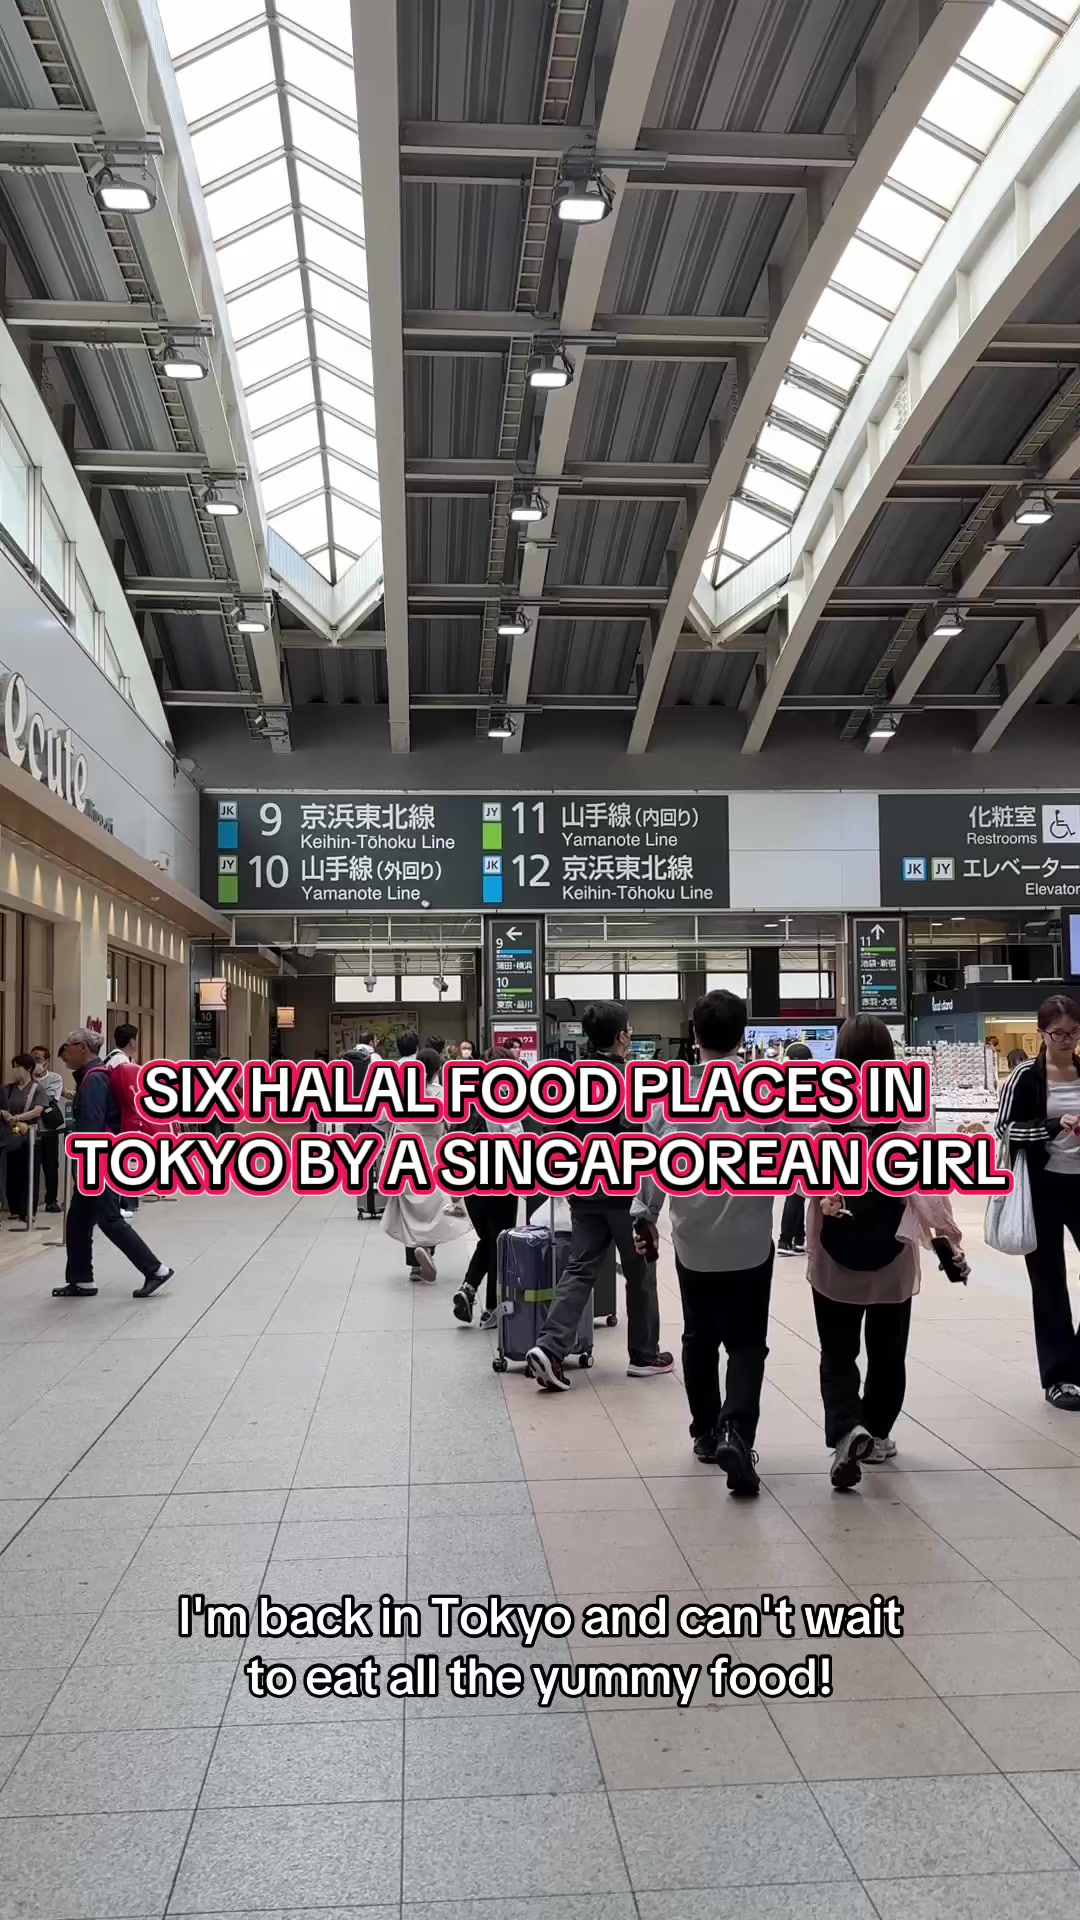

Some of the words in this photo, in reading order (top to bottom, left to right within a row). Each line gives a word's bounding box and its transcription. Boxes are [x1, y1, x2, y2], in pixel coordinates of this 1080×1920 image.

[221, 806, 235, 816] JK
[300, 803, 436, 830] 京浜東北線
[486, 807, 499, 817] JY
[511, 801, 545, 834] 11
[968, 805, 1037, 829] 化粧室
[259, 802, 282, 836] 9
[300, 834, 417, 850] Keihin-Tōhoku
[421, 834, 456, 850] Line
[562, 832, 641, 847] Yamanote
[645, 832, 678, 847] Line
[966, 832, 1038, 845] Restrooms
[221, 859, 235, 869] JY
[248, 855, 289, 888] 10
[486, 860, 499, 870] JK
[511, 854, 551, 888] 12
[562, 854, 694, 881] 京浜東北線
[906, 864, 922, 875] JK
[935, 864, 950, 875] JY
[963, 857, 1080, 879] エレベーター
[301, 885, 382, 901] Yamanote
[387, 885, 421, 901] Line
[562, 885, 676, 900] Keihin-Tōhoku
[680, 885, 714, 900] Line
[496, 938, 504, 949] 9
[860, 936, 871, 946] 11
[496, 977, 509, 988] 10
[860, 974, 873, 985] 12
